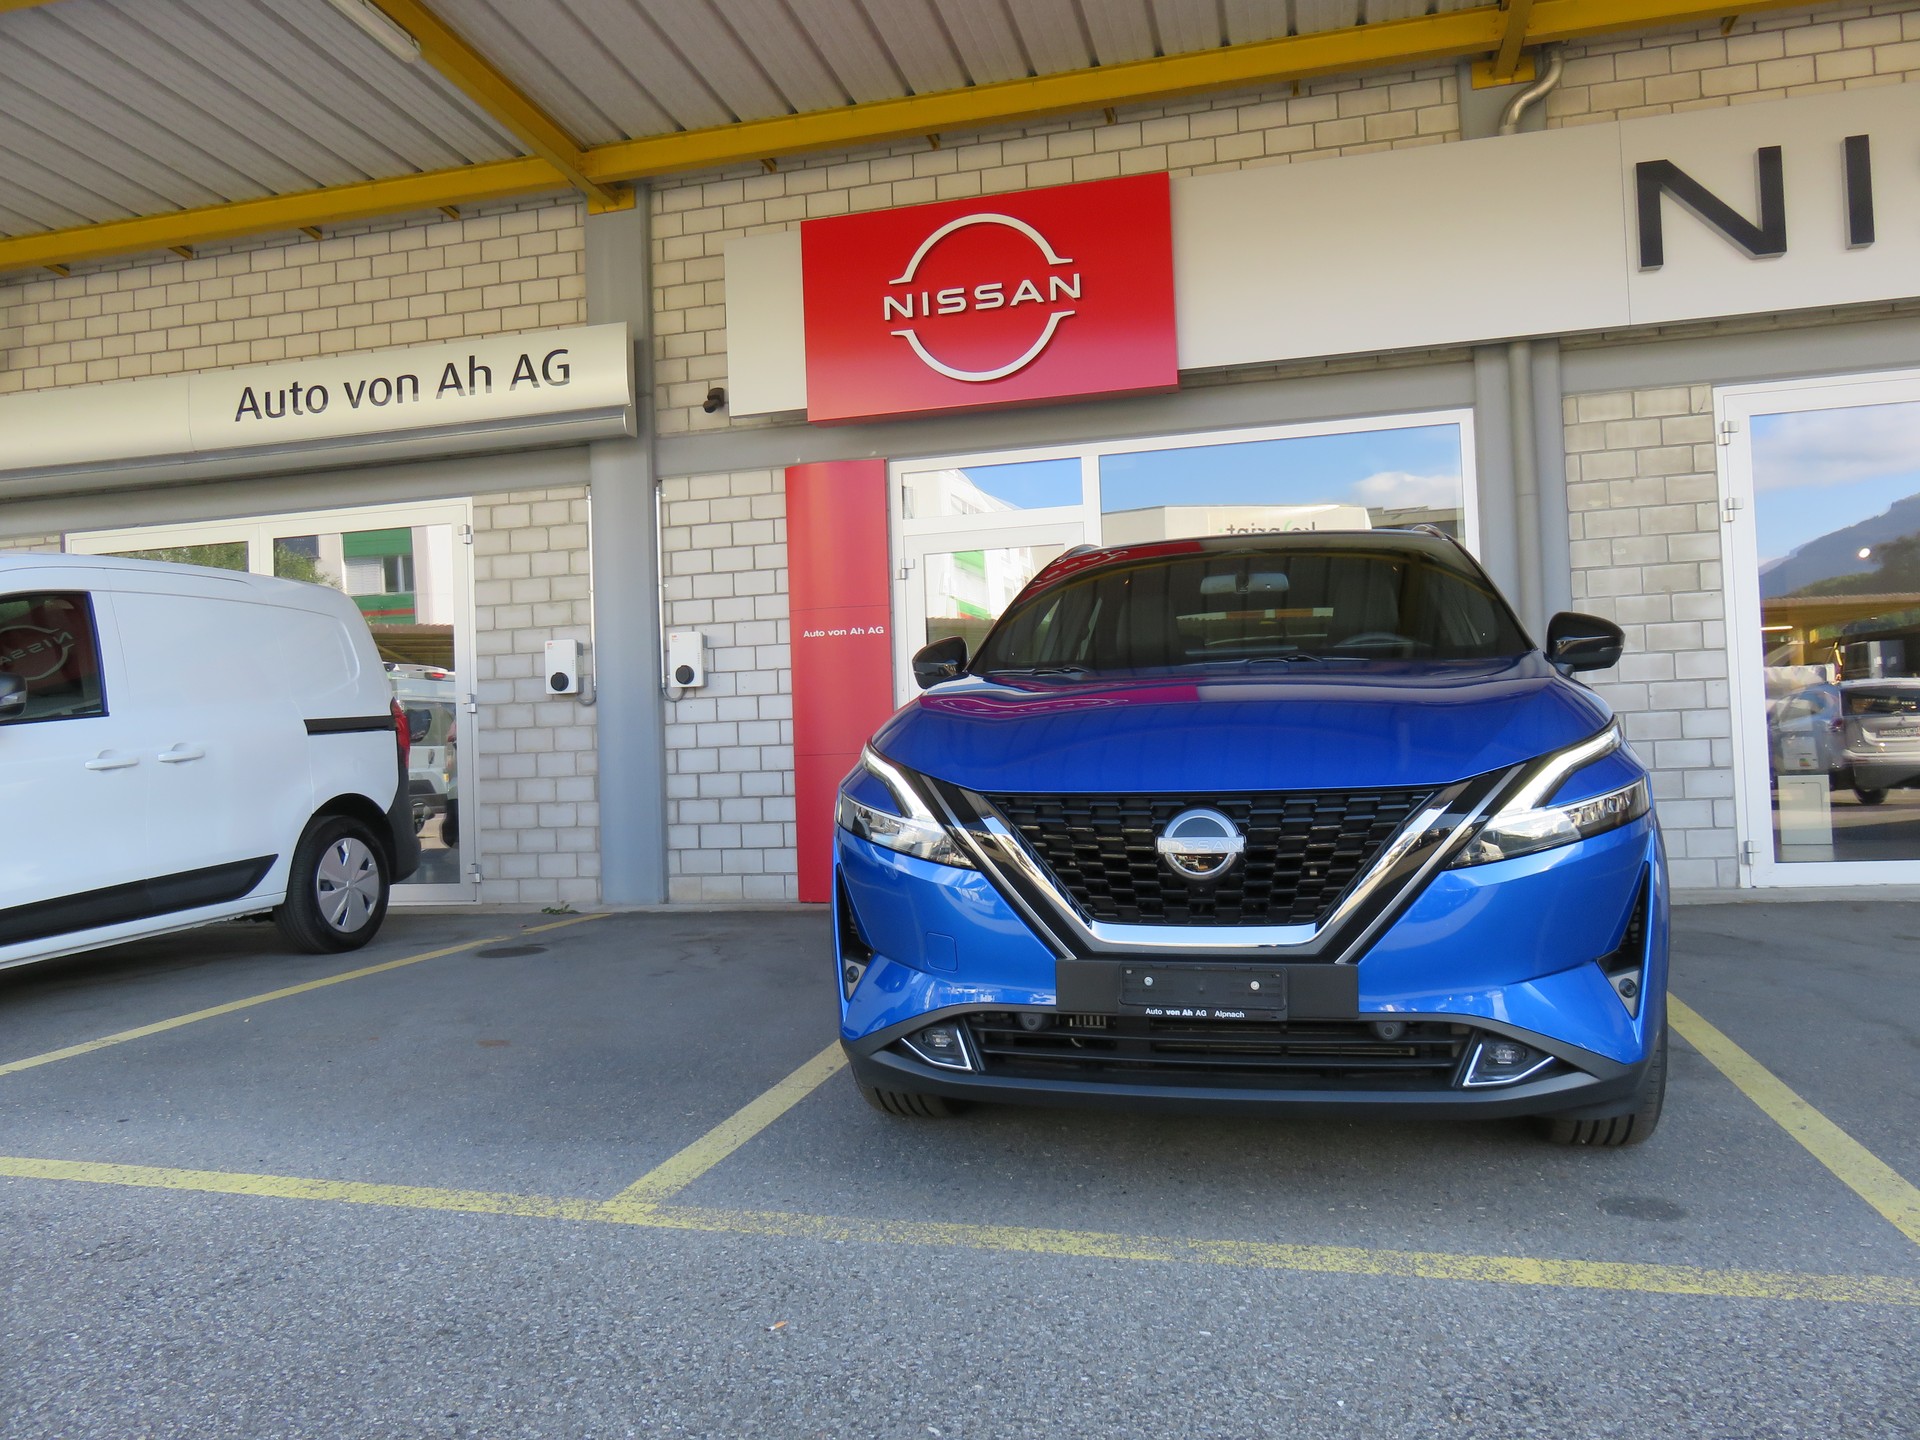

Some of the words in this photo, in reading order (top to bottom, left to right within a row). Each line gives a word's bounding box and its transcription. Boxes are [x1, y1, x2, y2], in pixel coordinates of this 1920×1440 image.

[883, 273, 1081, 321] NISSAN
[235, 381, 329, 422] Auto
[343, 373, 419, 409] von
[436, 355, 492, 400] Ah
[509, 348, 570, 391] AG
[827, 629, 847, 637] von
[850, 627, 865, 635] Ah
[868, 626, 884, 634] AG
[1159, 840, 1241, 852] NISSAN
[1145, 1008, 1163, 1016] Auto
[1165, 1009, 1180, 1017] von
[1182, 1009, 1194, 1017] Ah
[1214, 1010, 1245, 1019] Alpnach
